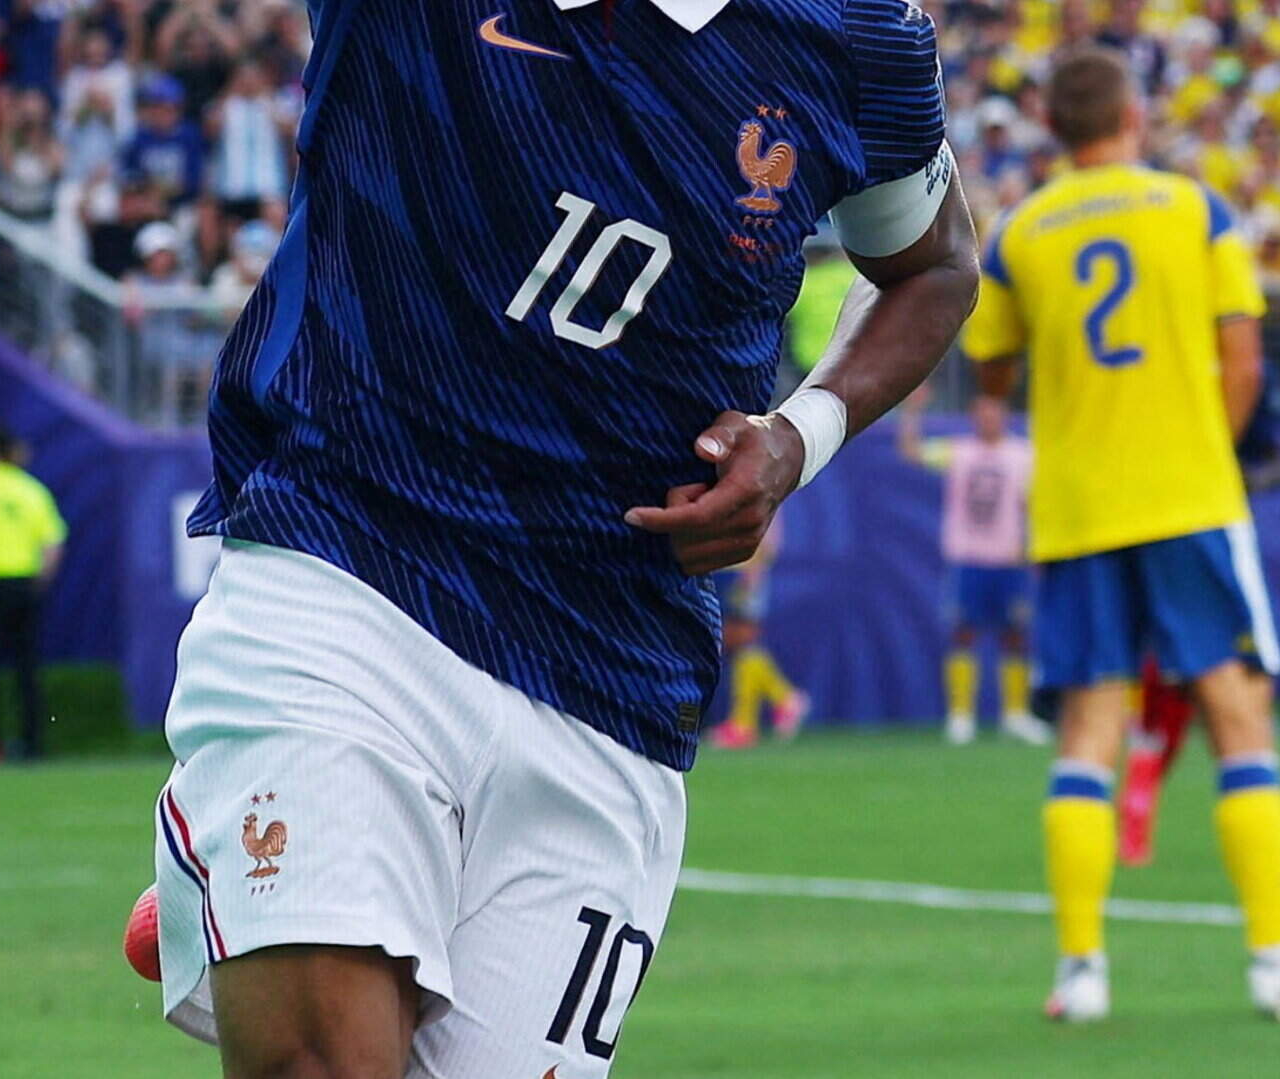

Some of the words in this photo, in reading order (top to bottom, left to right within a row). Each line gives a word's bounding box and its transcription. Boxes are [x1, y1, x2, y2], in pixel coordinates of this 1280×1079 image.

[505, 191, 672, 349] 10
[1074, 237, 1144, 367] 2
[545, 905, 654, 1060] 10
